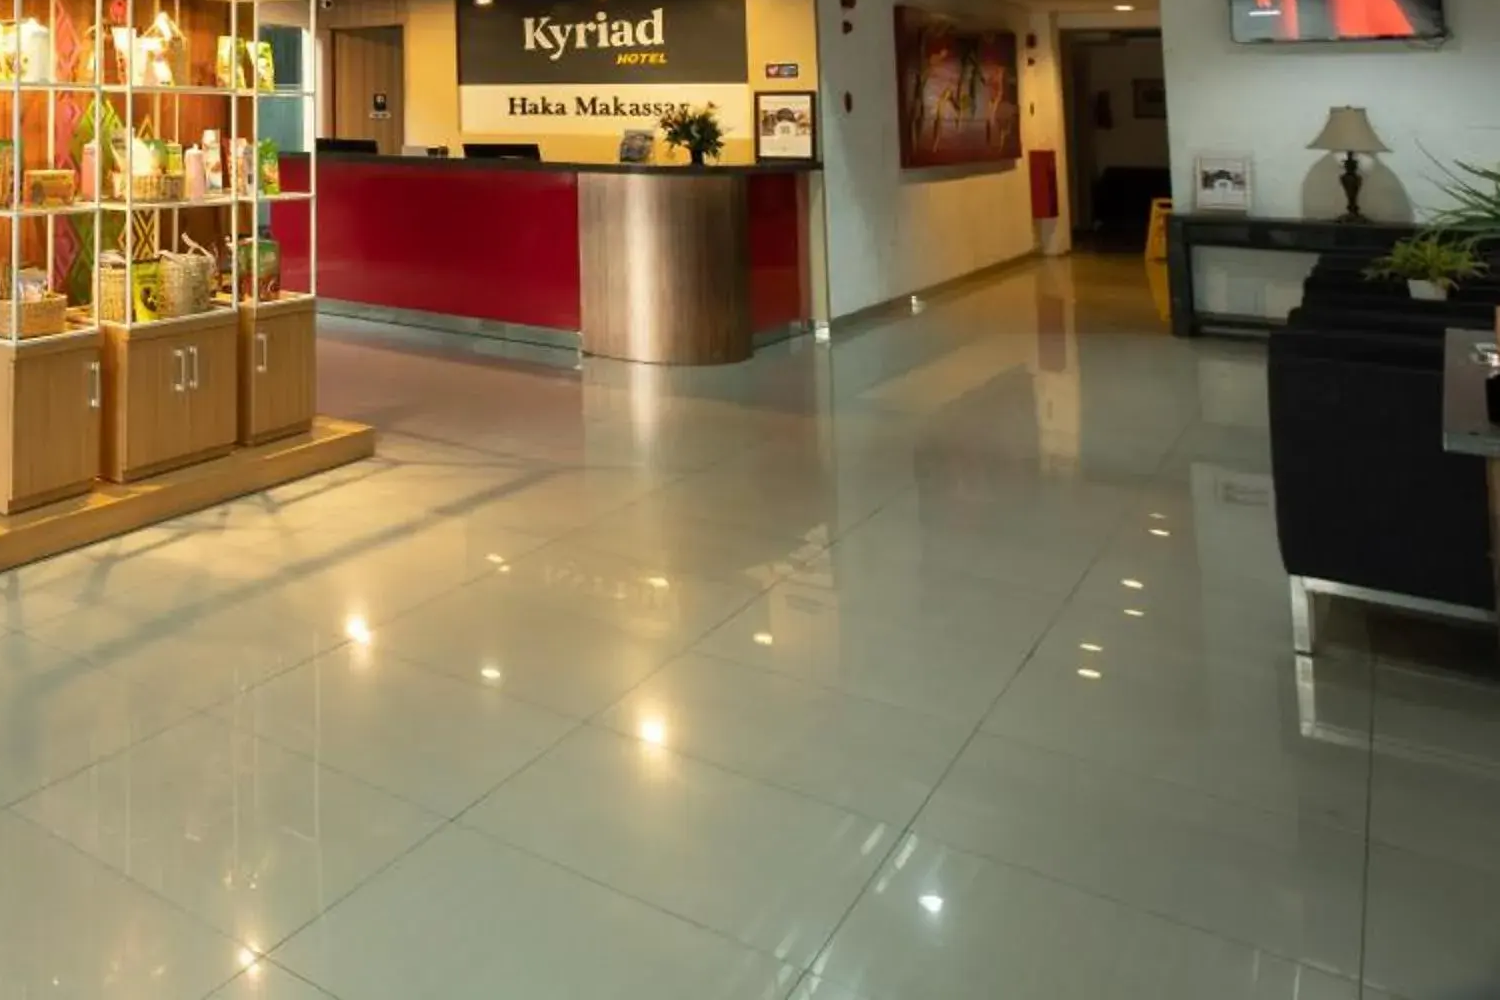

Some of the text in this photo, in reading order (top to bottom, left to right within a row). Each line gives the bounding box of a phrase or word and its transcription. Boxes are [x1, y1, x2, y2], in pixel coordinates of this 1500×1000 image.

[523, 7, 665, 61] Kyriad
[615, 52, 668, 65] HOTEL
[508, 97, 566, 116] Haka
